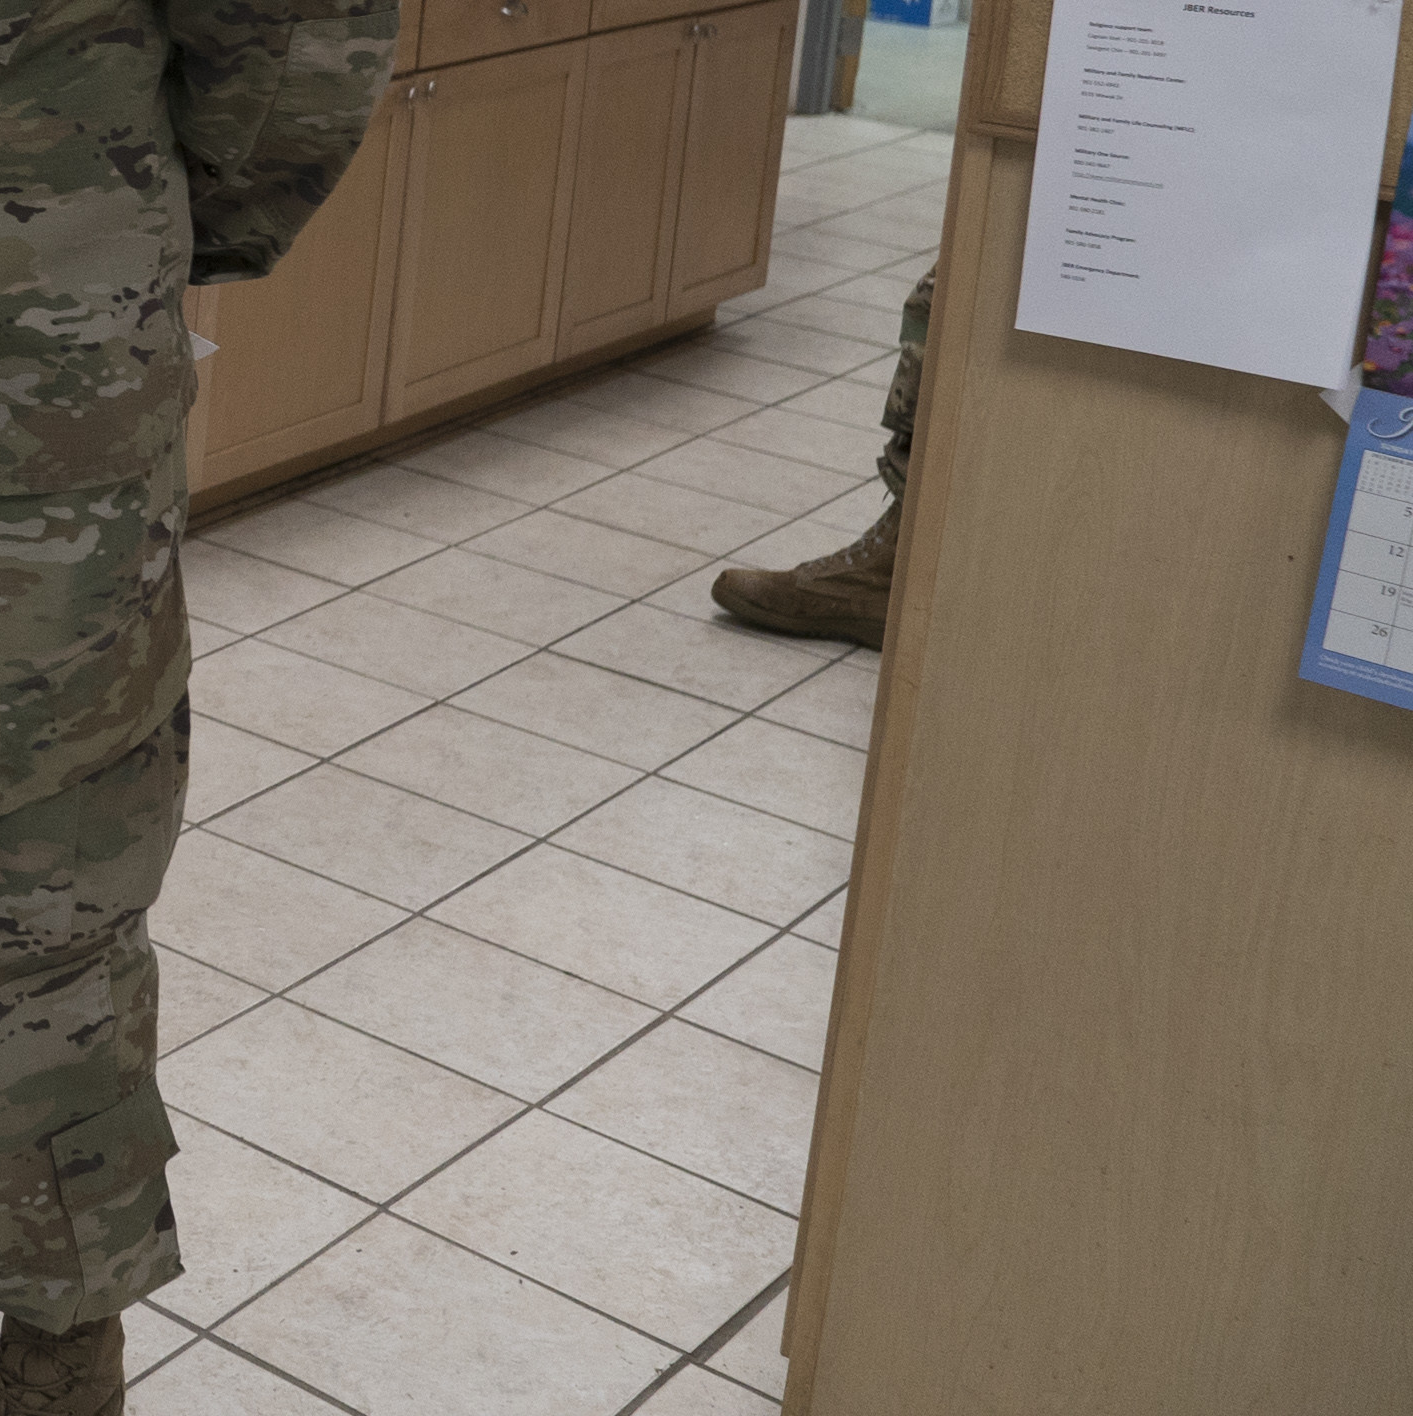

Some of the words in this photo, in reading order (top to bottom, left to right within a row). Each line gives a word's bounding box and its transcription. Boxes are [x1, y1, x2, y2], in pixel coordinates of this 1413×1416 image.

[1183, 3, 1205, 13] JBER
[1208, 6, 1255, 18] Resources
[1388, 544, 1404, 558] 12
[1380, 585, 1396, 597] 19
[1371, 624, 1388, 638] 26
